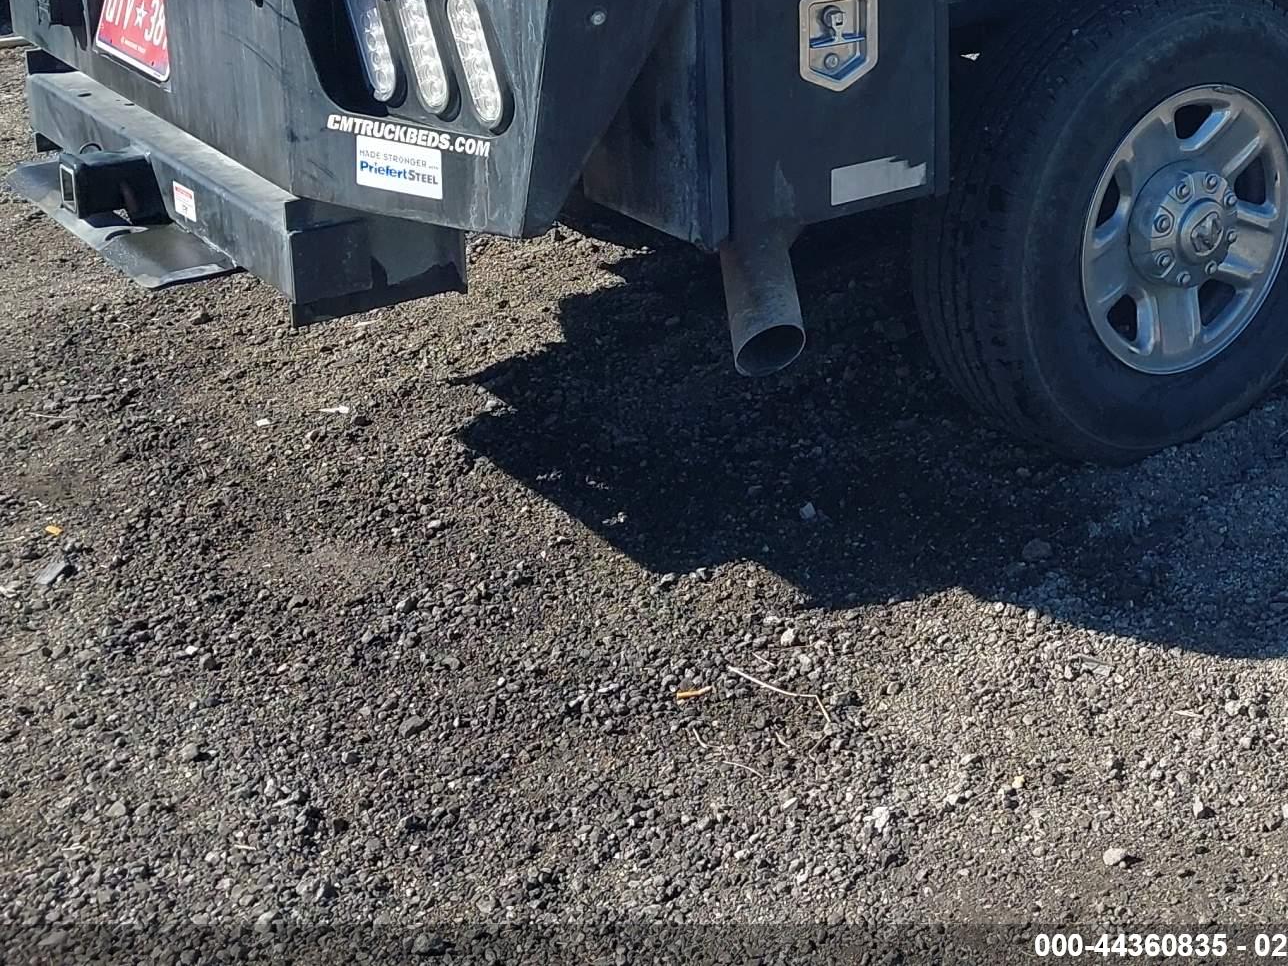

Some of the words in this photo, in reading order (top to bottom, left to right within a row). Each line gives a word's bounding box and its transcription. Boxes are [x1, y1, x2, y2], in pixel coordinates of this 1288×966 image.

[326, 114, 491, 157] CMTRUCKBEDS.COM
[359, 149, 381, 160] MADE
[383, 153, 427, 168] STRONGER
